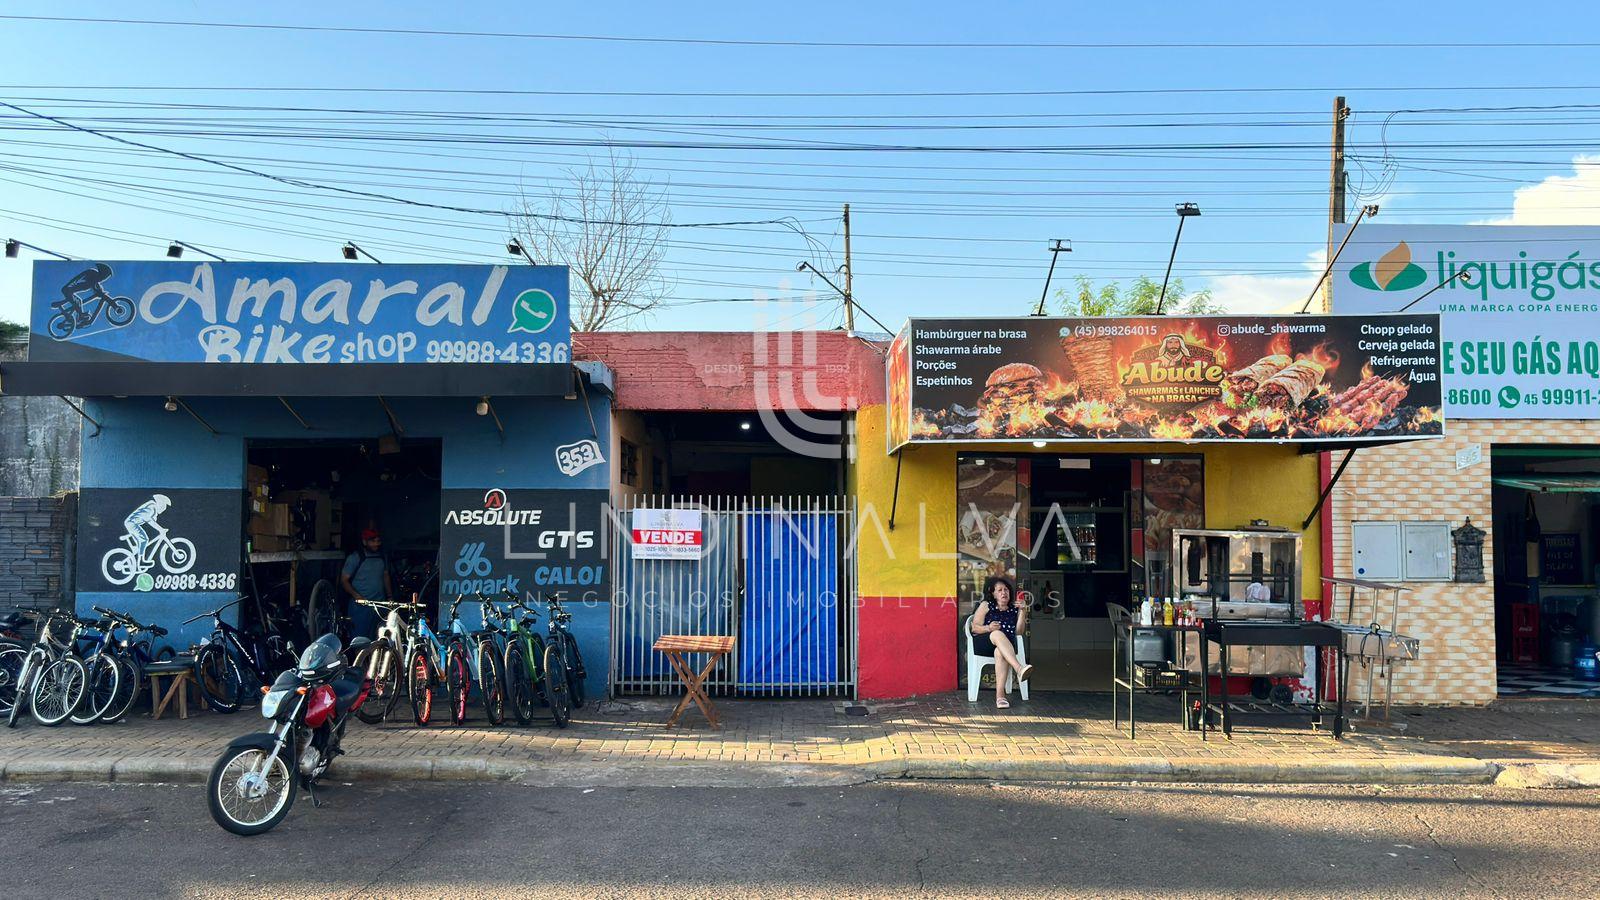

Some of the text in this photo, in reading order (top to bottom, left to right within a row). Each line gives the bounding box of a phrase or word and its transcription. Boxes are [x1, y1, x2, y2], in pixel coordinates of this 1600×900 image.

[1437, 250, 1600, 301] liquigás
[139, 261, 509, 326] Amaral
[1440, 304, 1466, 312] UMA
[1471, 304, 1514, 312] MARCA
[1519, 304, 1551, 312] COPA
[916, 328, 1027, 341] Hambúrguer na brasa
[1074, 325, 1157, 338] (45) 998264015
[1231, 323, 1326, 336] abude_shawarma
[1360, 324, 1433, 336] Chopp gelado
[198, 324, 335, 363] Bike
[339, 331, 417, 363] shop
[915, 344, 970, 354] Shawarma
[972, 344, 1001, 354] árabe
[1358, 340, 1435, 352] Cerveja gelada
[1370, 355, 1436, 367] Refrigerante
[1460, 341, 1506, 375] SEU
[1512, 335, 1561, 375] GÁS
[916, 360, 957, 371] Porções
[916, 376, 973, 388] Espetinhos
[1408, 368, 1436, 383] Água
[1128, 386, 1179, 396] SHAWARMAS
[1184, 387, 1220, 395] LANCHES
[1524, 393, 1538, 405] 45
[1542, 388, 1600, 405] 99911-
[1151, 395, 1197, 403] NA BRASA
[560, 444, 594, 471] 353
[445, 510, 542, 525] ABSOLUTE
[538, 531, 594, 549] GTS
[640, 531, 694, 544] VENDE
[535, 566, 603, 586] CALOI
[442, 574, 520, 596] monark
